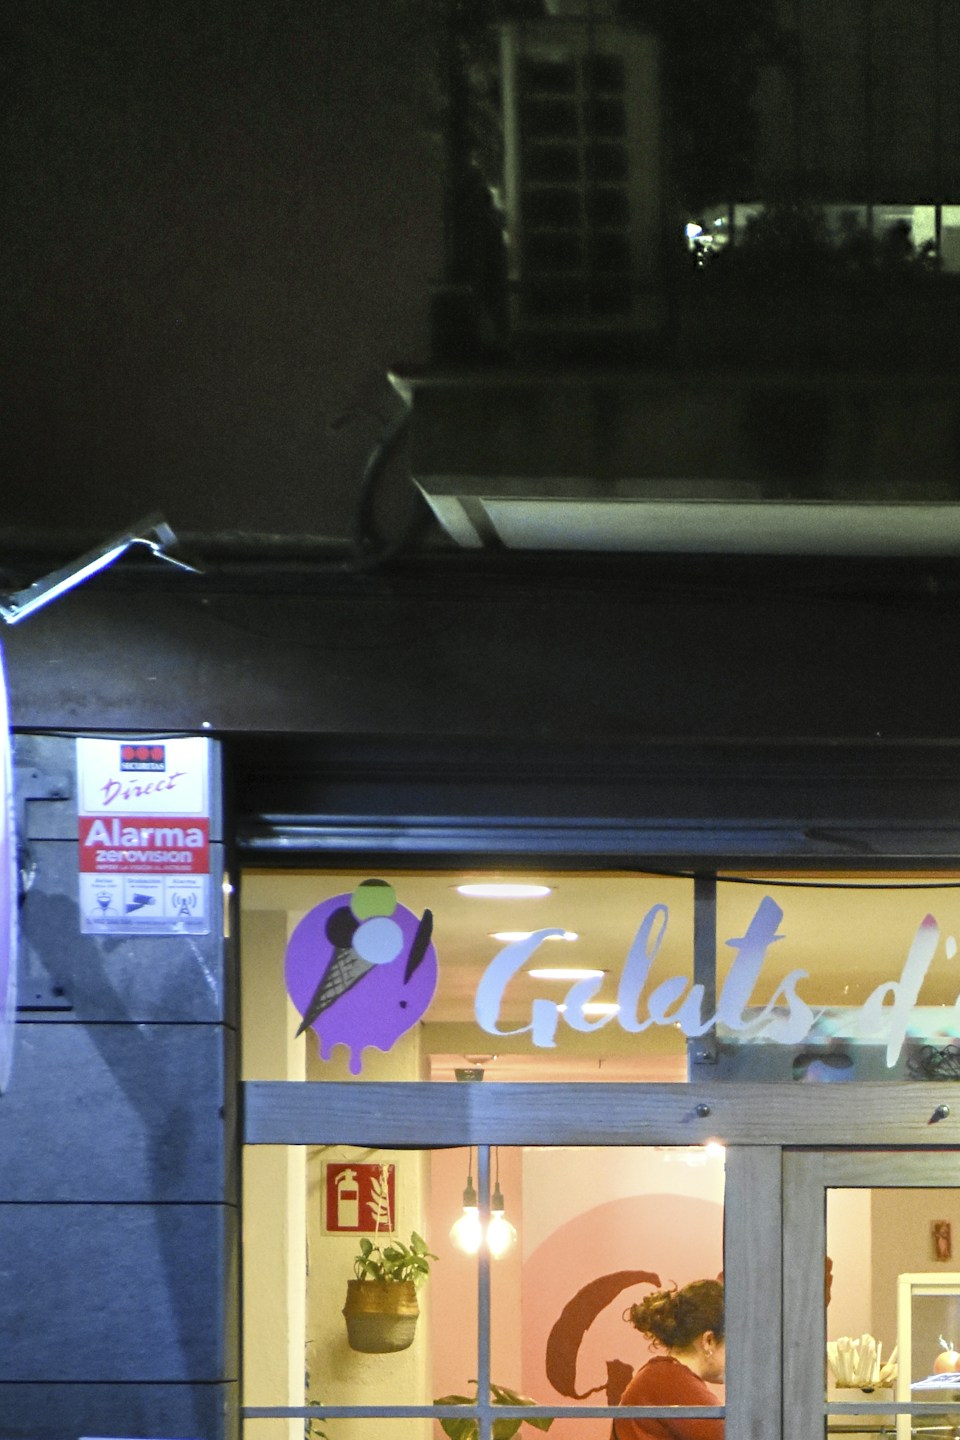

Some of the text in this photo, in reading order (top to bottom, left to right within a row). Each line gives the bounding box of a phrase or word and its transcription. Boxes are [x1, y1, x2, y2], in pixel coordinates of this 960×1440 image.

[100, 772, 187, 806] Direct
[84, 818, 204, 848] Alarma
[95, 850, 193, 863] zerovision
[474, 894, 824, 1047] Gelats
